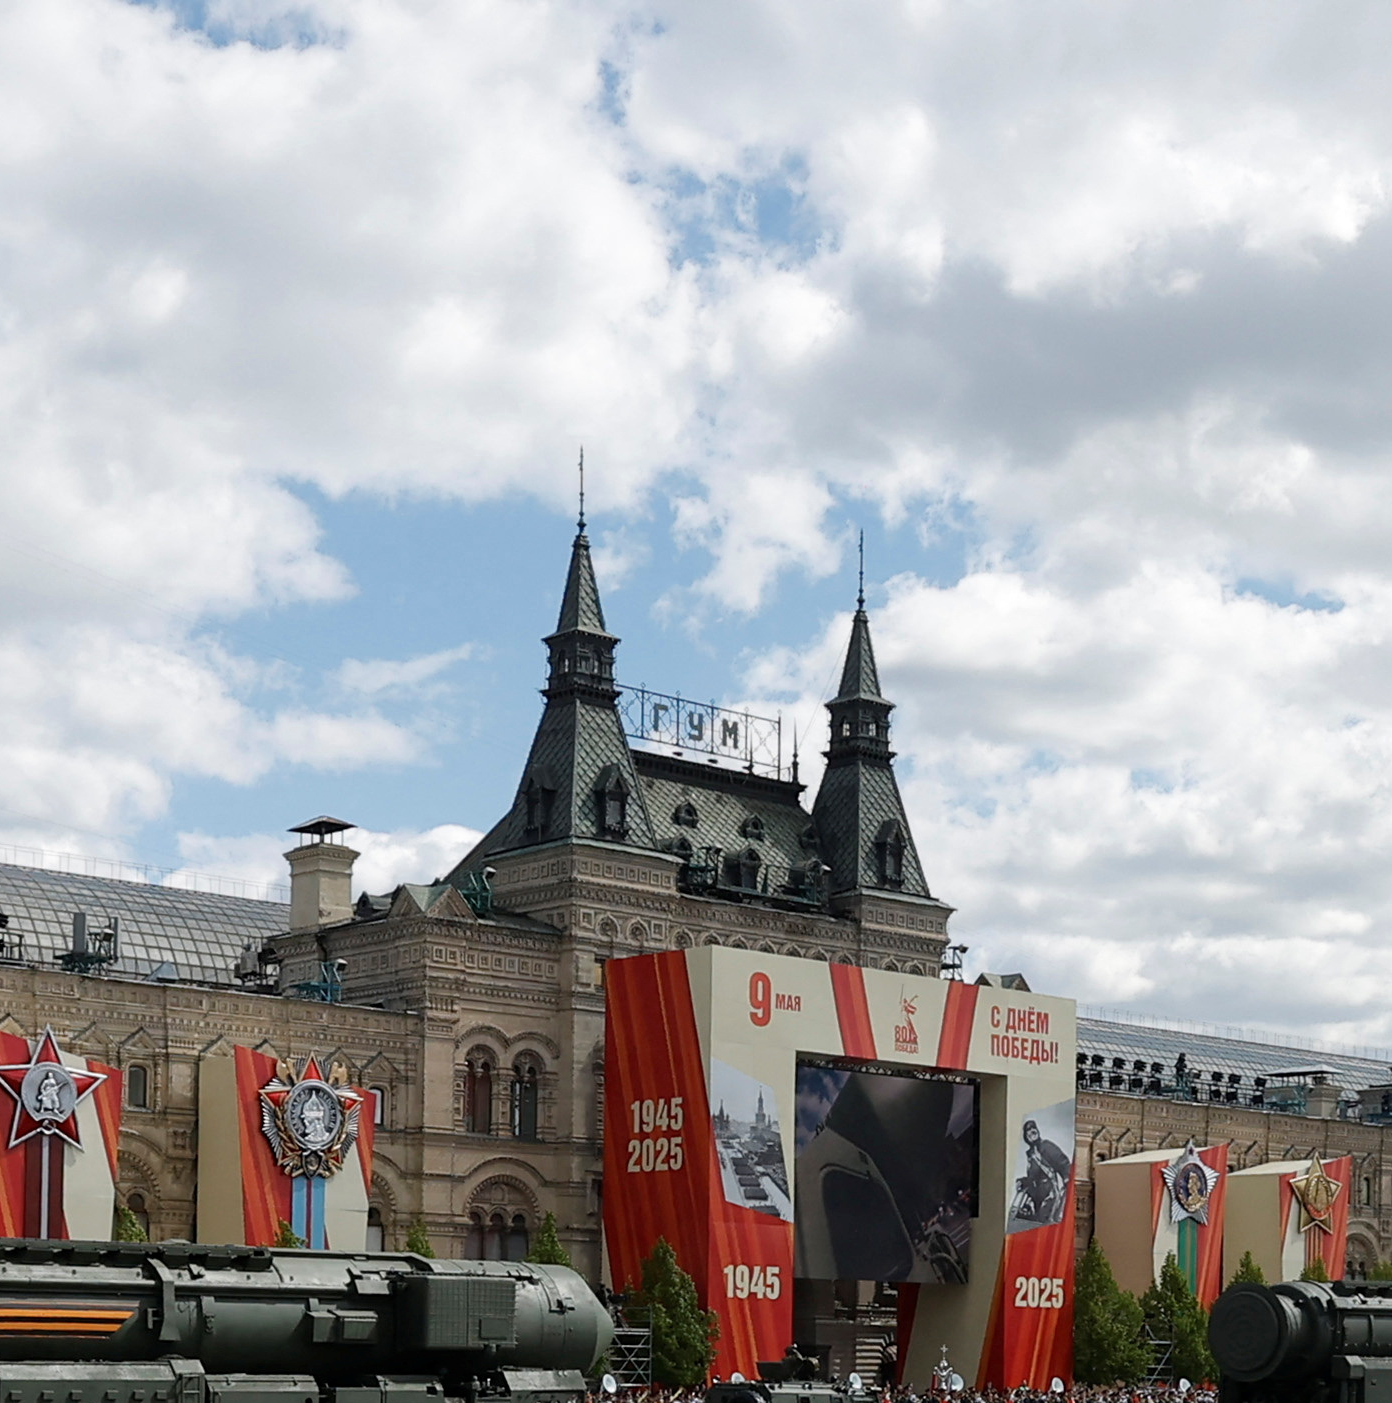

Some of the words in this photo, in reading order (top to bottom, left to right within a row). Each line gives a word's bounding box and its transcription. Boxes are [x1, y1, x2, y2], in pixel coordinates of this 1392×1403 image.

[653, 703, 738, 749] ГУМ
[749, 971, 771, 1027] 9
[775, 993, 801, 1012] МАЯ
[991, 1005, 1001, 1028] С
[1005, 1006, 1049, 1035] ДНЁМ
[990, 1034, 1059, 1065] ПОБЕДЫ!
[630, 1097, 683, 1133] 1945
[627, 1137, 683, 1173] 2025
[723, 1264, 780, 1300] 1945
[1014, 1276, 1064, 1309] 2025
